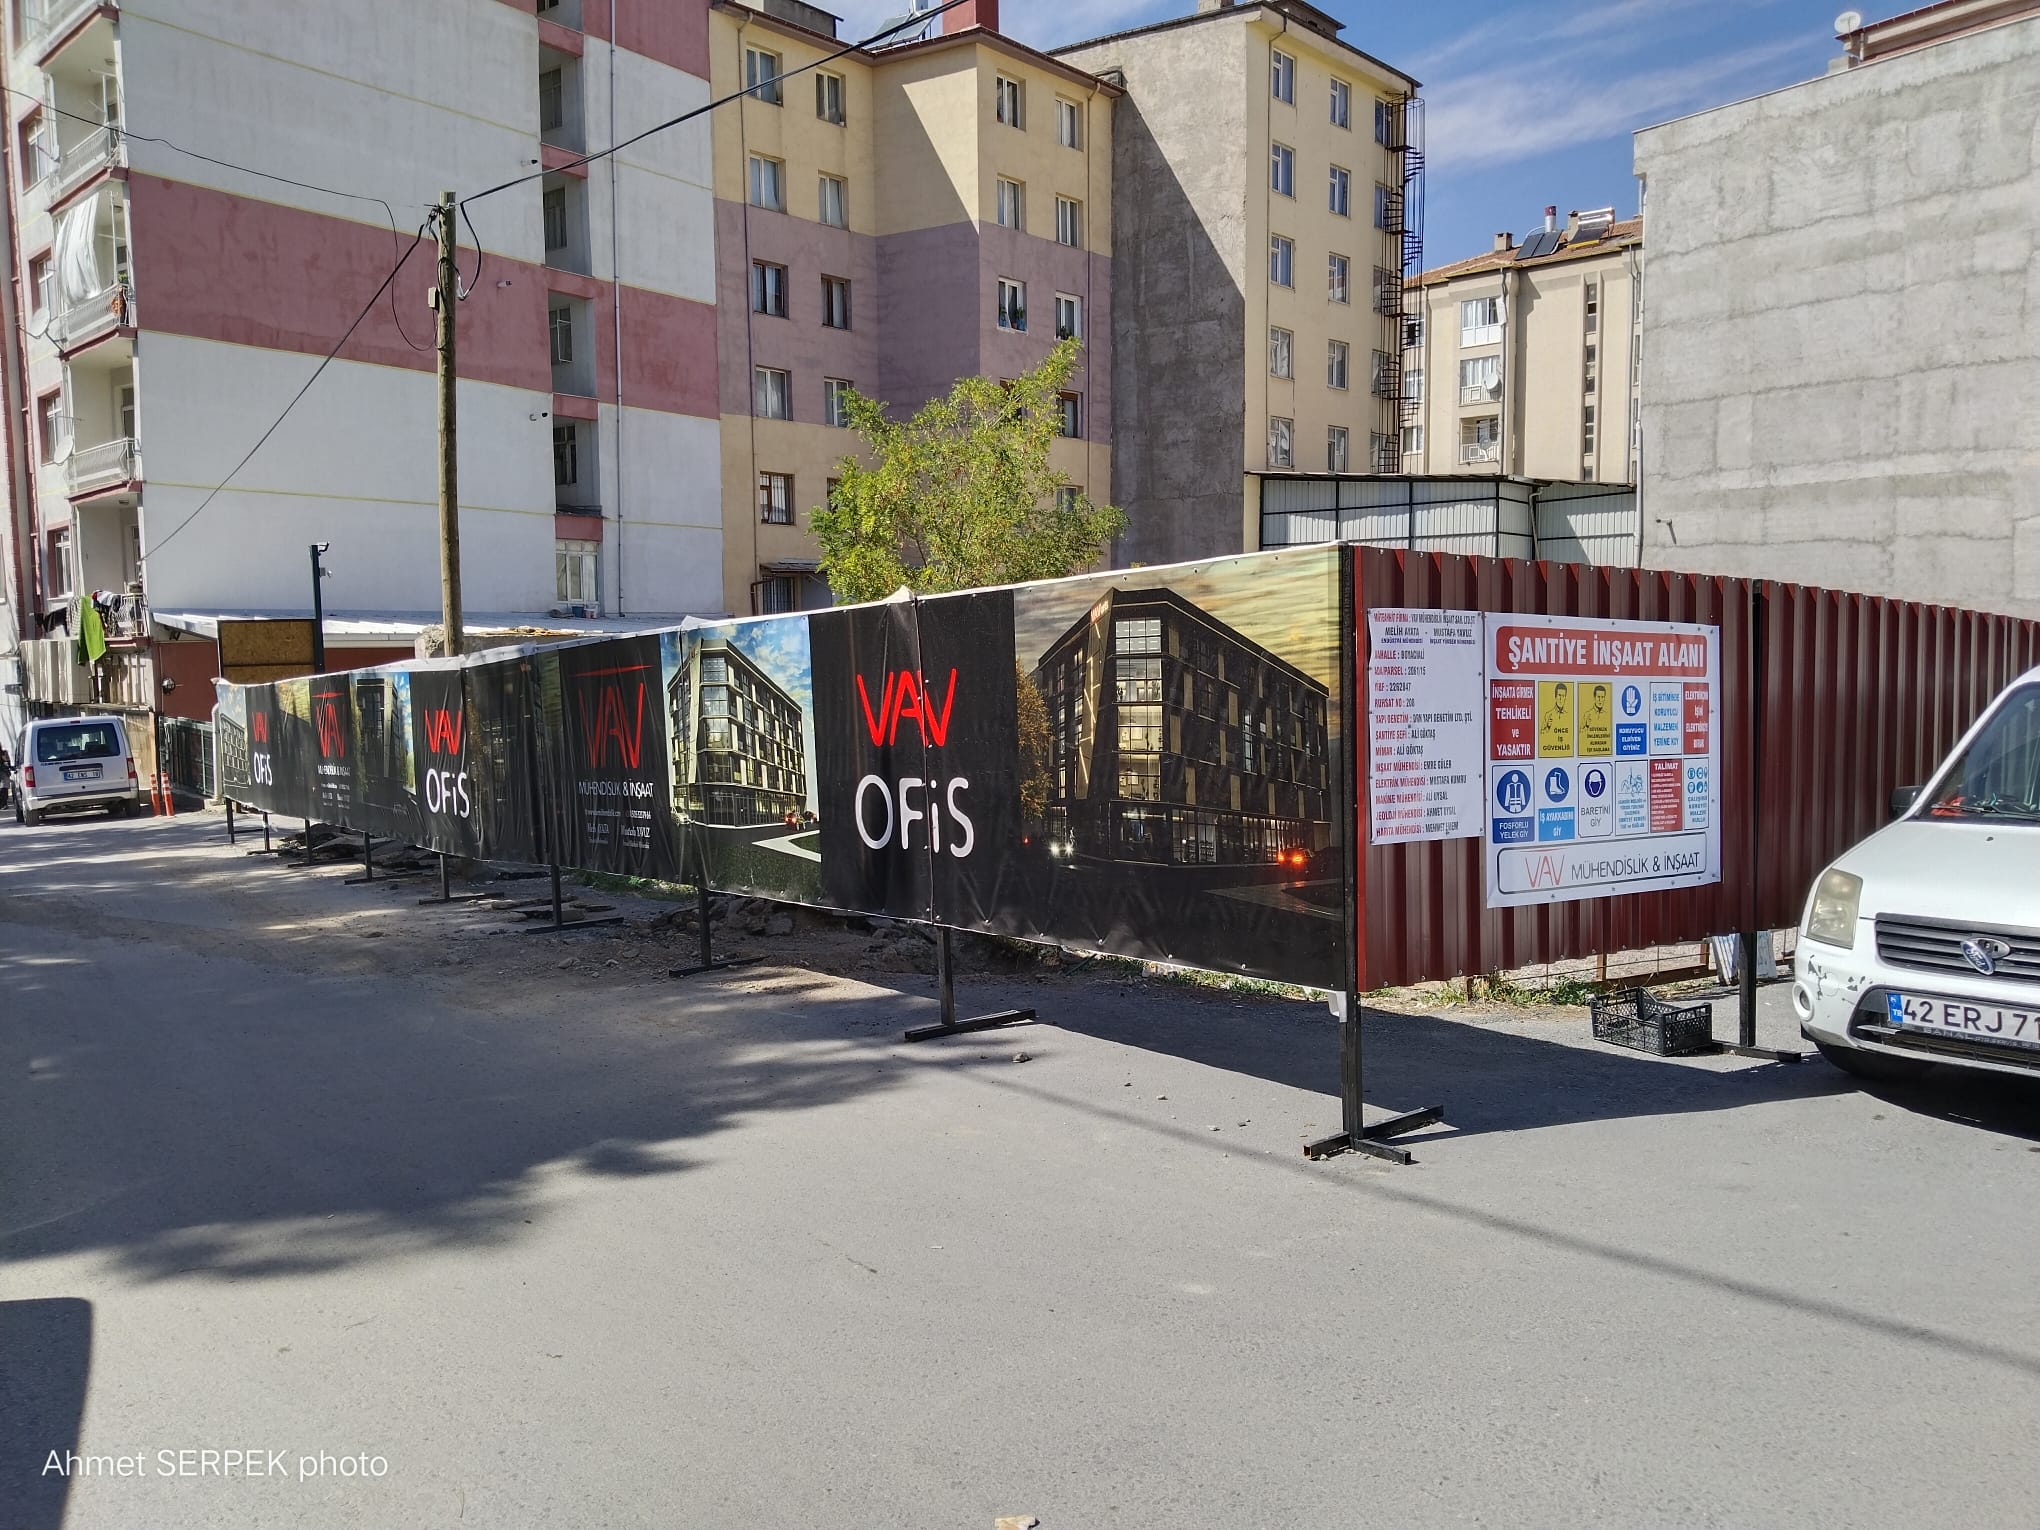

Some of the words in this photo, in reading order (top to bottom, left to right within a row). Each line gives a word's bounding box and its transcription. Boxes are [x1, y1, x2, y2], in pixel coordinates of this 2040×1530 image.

[1508, 632, 1587, 670] ŞANTİYE
[1593, 634, 1654, 672] İNŞAAT
[1658, 642, 1703, 668] ALANI
[1492, 684, 1516, 701] İNŞAATA
[1516, 684, 1533, 698] GİRMEK
[857, 668, 956, 747] VAV
[1496, 705, 1531, 720] TEHLİKELİ
[424, 709, 462, 756] VAV
[578, 682, 644, 768] VAV
[1511, 728, 1520, 738] ve
[1497, 744, 1531, 756] YASAKTIR
[1654, 762, 1679, 770] TALİMAT
[579, 779, 620, 796] MÜHENDİSLİK
[629, 778, 654, 799] İNŞAAT
[1581, 804, 1610, 815] BARETİNİ
[1500, 821, 1529, 830] FOSFORLU
[1590, 817, 1601, 827] GİY
[1500, 831, 1519, 839] YELEK
[1553, 825, 1561, 837] GİY
[1525, 854, 1565, 888] VAV
[1572, 854, 1648, 880] MÜHENDİSLİK
[1653, 856, 1660, 872] &
[1664, 850, 1700, 872] İNŞAAT
[1904, 1000, 1934, 1023] 42
[1944, 1004, 2002, 1032] ERJ
